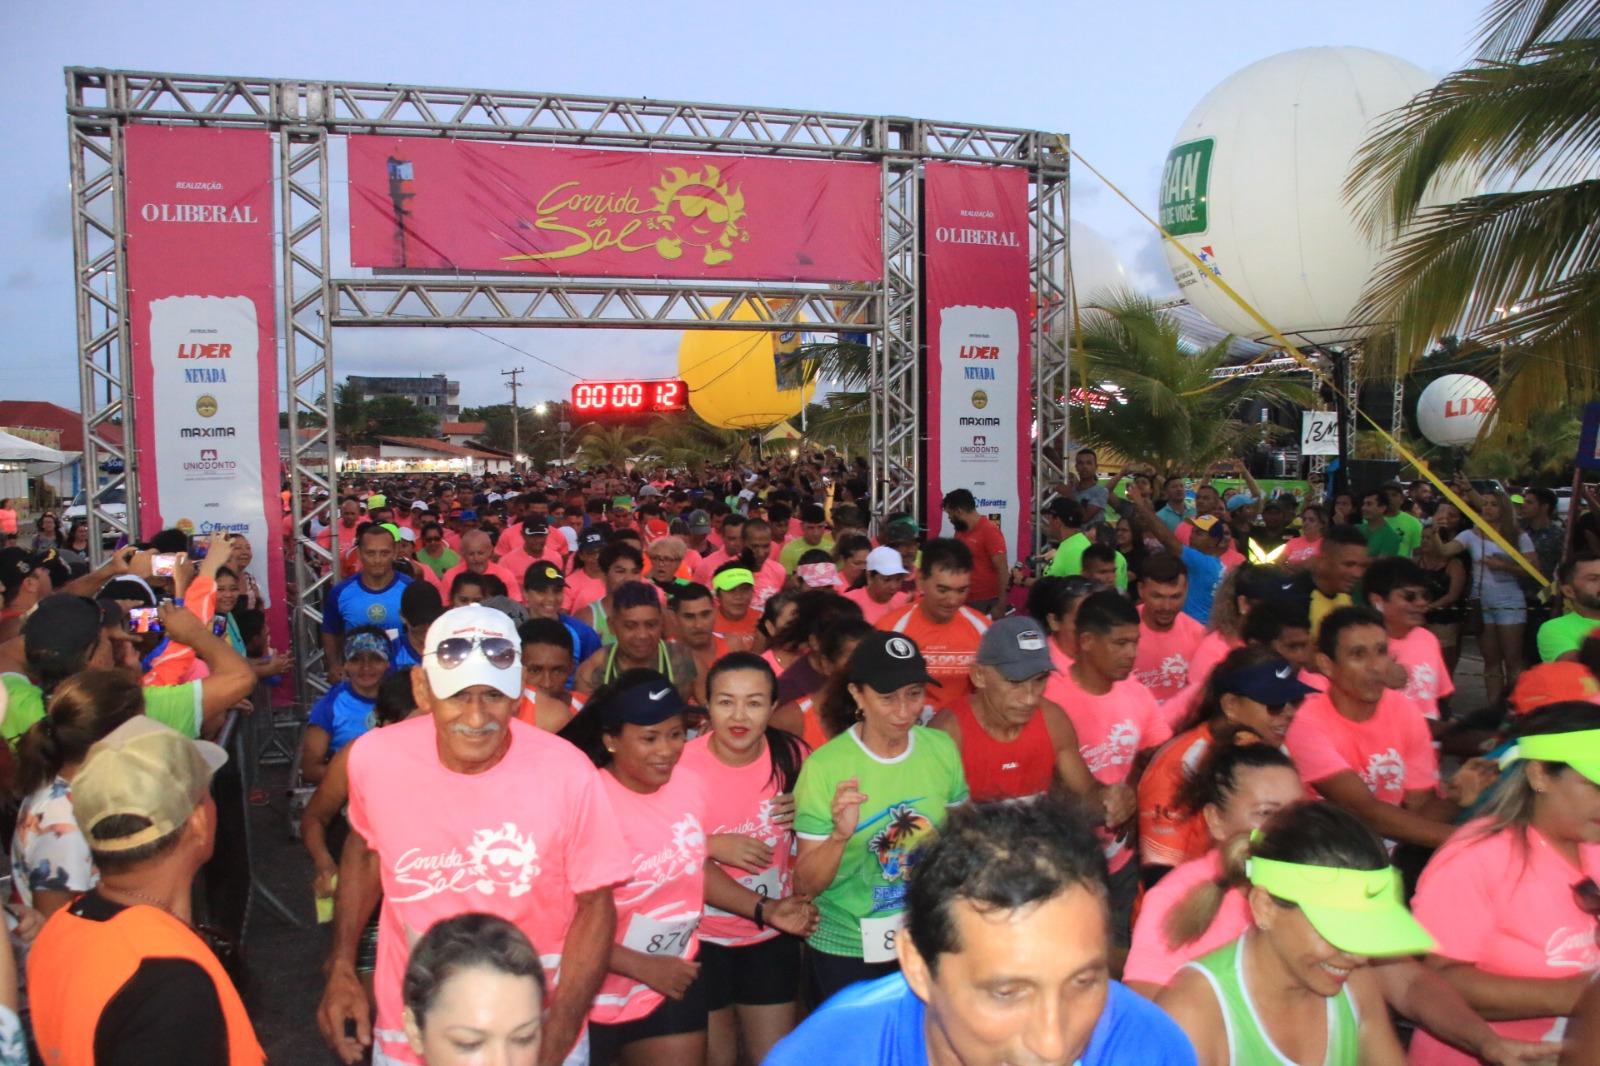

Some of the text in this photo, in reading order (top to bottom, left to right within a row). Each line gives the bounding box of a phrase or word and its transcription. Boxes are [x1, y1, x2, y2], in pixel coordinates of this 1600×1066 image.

[536, 180, 648, 216] Corrida
[184, 368, 227, 384] NEVADA
[963, 366, 996, 381] NEVADA
[576, 383, 678, 408] 00 00 12
[959, 417, 1001, 426] MAXIMA
[180, 426, 236, 438] MAXIMA
[183, 460, 237, 470] UNIODONTO
[394, 847, 470, 874] Corrida
